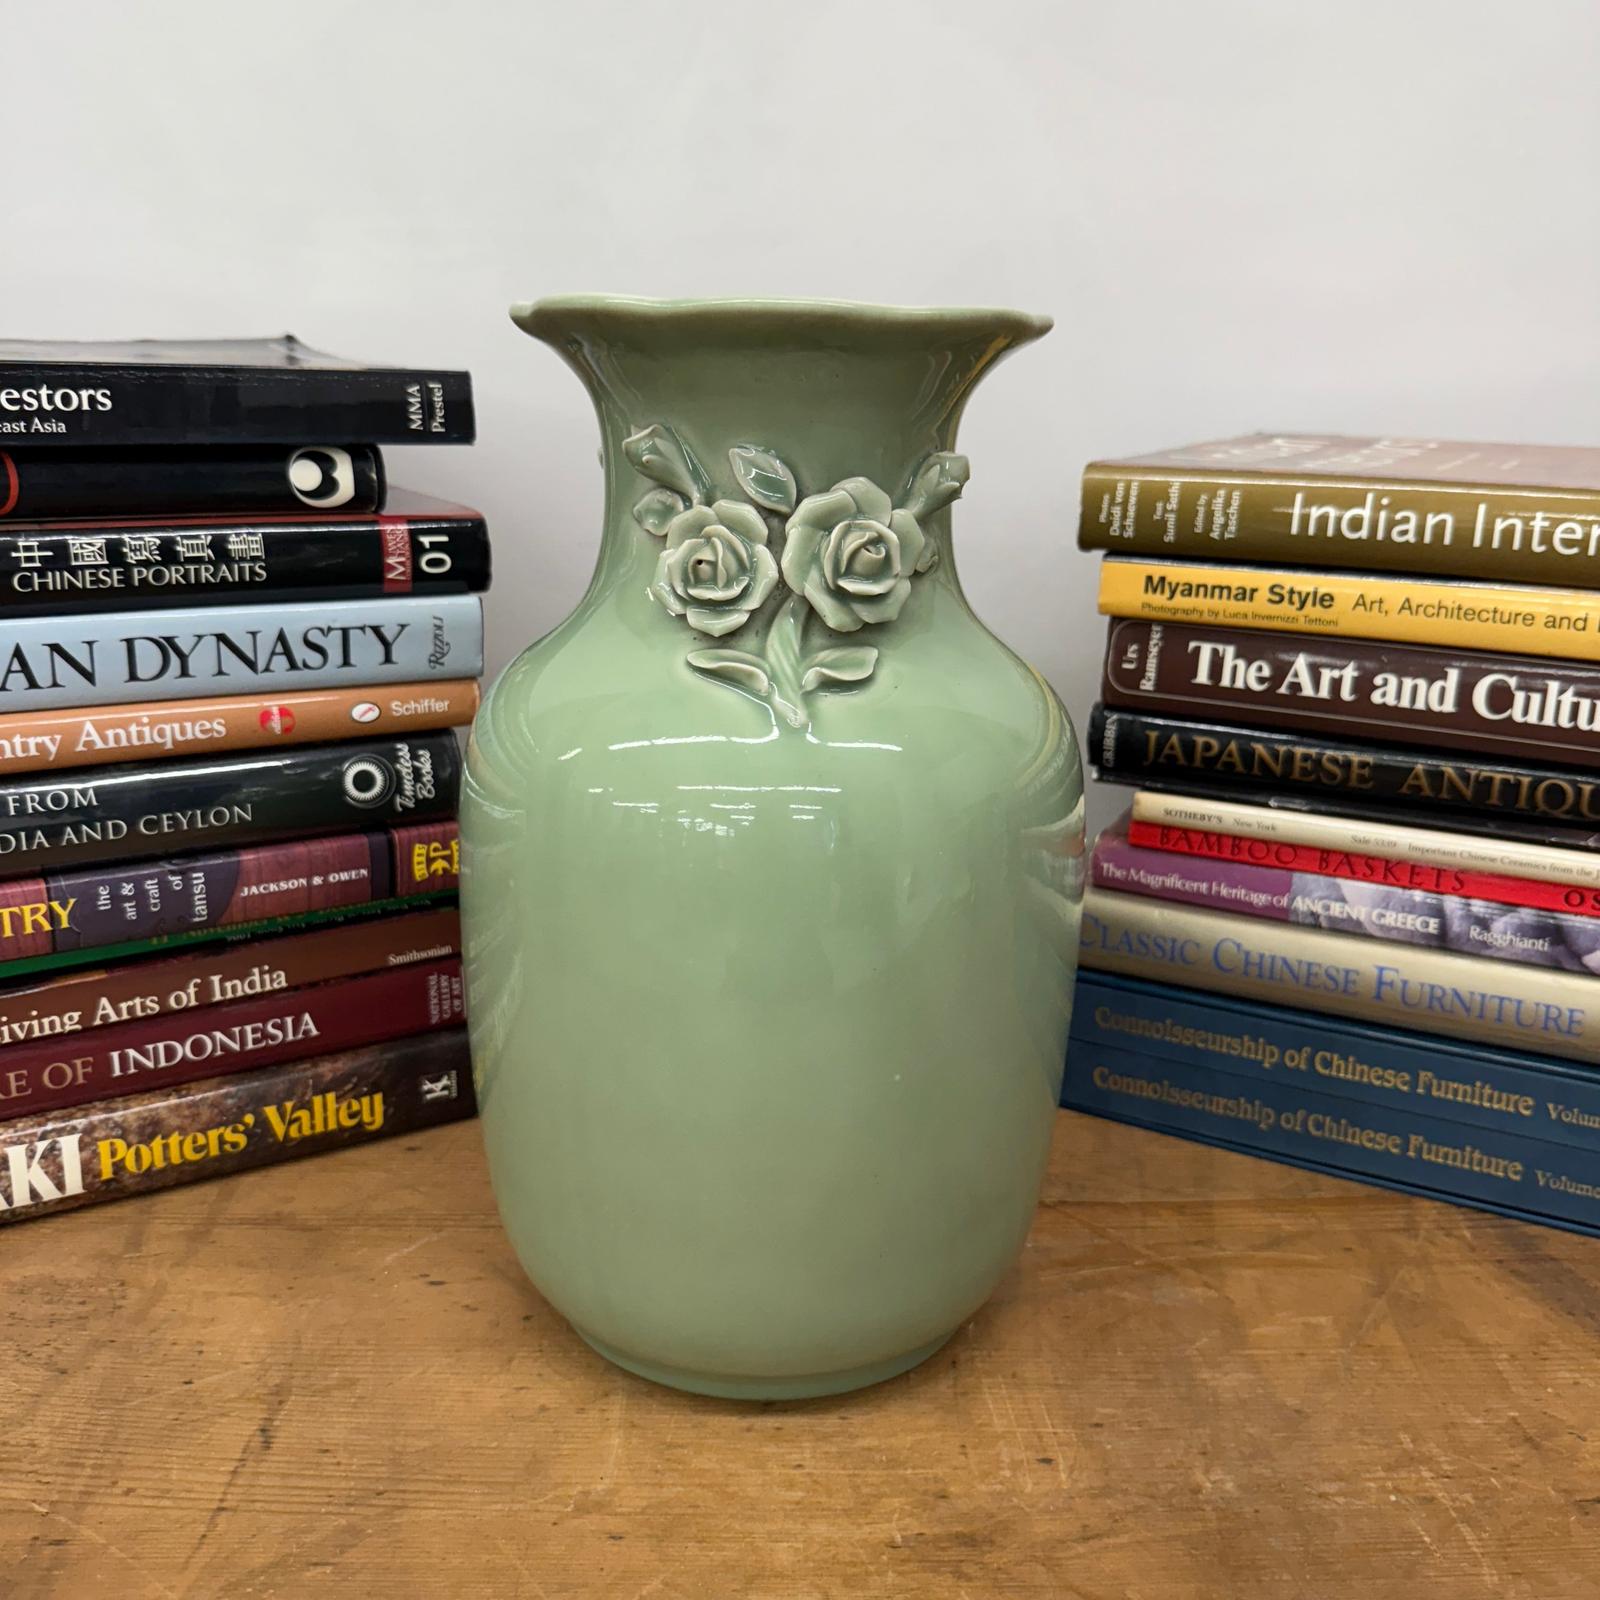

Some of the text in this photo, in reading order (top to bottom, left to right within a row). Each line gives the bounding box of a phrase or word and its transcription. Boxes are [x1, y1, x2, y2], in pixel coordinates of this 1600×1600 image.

[0, 383, 113, 412] estors
[405, 384, 424, 430] MMA
[428, 382, 446, 433] Prestel
[0, 416, 67, 433] ast Asia
[1115, 481, 1125, 503] von
[1209, 489, 1226, 540] Angelika
[1223, 489, 1241, 540] Taschen
[1163, 511, 1176, 543] Sunil
[1290, 492, 1453, 546] Indian
[12, 562, 268, 592] CHINESE PORTRAITS
[418, 533, 452, 574] 01
[1141, 602, 1204, 618] Photography
[1207, 608, 1220, 619] by
[1222, 610, 1249, 621] Luca
[1303, 616, 1339, 628] Tettoni
[1143, 574, 1259, 602] Myanmar
[1266, 584, 1336, 611] Style
[1351, 593, 1389, 616] Art,
[1397, 597, 1536, 628] Architecture
[1544, 612, 1589, 632] and
[0, 623, 411, 692] AN DYNASTY
[1121, 642, 1140, 670] Urs
[1139, 623, 1163, 691] Ramseyer
[1187, 640, 1273, 692] The
[1275, 652, 1359, 702] Art
[1370, 667, 1460, 713] and
[391, 699, 450, 717] Schiffer
[75, 716, 226, 752] Antiques
[412, 749, 436, 800] Books
[1143, 730, 1376, 790] JAPANESE
[7, 787, 99, 816] FROM
[60, 819, 128, 846] AND
[139, 803, 253, 836] CEYLON
[1158, 826, 1298, 866] BAMBOO
[1316, 849, 1466, 892] BASKETS
[1163, 807, 1224, 825] SOTHEBY'S
[1232, 817, 1253, 829] New
[1407, 842, 1458, 858] Important
[1459, 849, 1498, 865] Chinese
[98, 884, 112, 911] the
[120, 882, 138, 921] art &
[144, 877, 161, 912] craft
[168, 874, 184, 891] of
[190, 872, 208, 922] tansu
[240, 867, 369, 898] JACKSON & OWEN
[0, 898, 77, 938] TRY
[1101, 862, 1551, 952] The Magnificent Heritage of ANCIENT GREECE Ragghianti
[388, 945, 453, 965] Smithsonian
[93, 996, 160, 1027] Arts
[169, 978, 202, 1008] of
[208, 964, 289, 1002] India
[1212, 937, 1360, 993] CHINESE
[1373, 964, 1586, 1037] FURNITURE
[0, 1011, 320, 1099] E OF INDONESIA
[1095, 1006, 1279, 1068] Connoisseurship
[1284, 1046, 1312, 1071] of
[1315, 1050, 1411, 1093] Chinese
[1416, 1070, 1536, 1117] Furniture
[98, 1113, 255, 1182] Potters'
[264, 1091, 385, 1143] Valley
[1092, 1066, 1276, 1131] Connoisseurship
[1279, 1108, 1306, 1132] of
[1307, 1113, 1403, 1155] Chinese
[1407, 1133, 1525, 1182] Furniture
